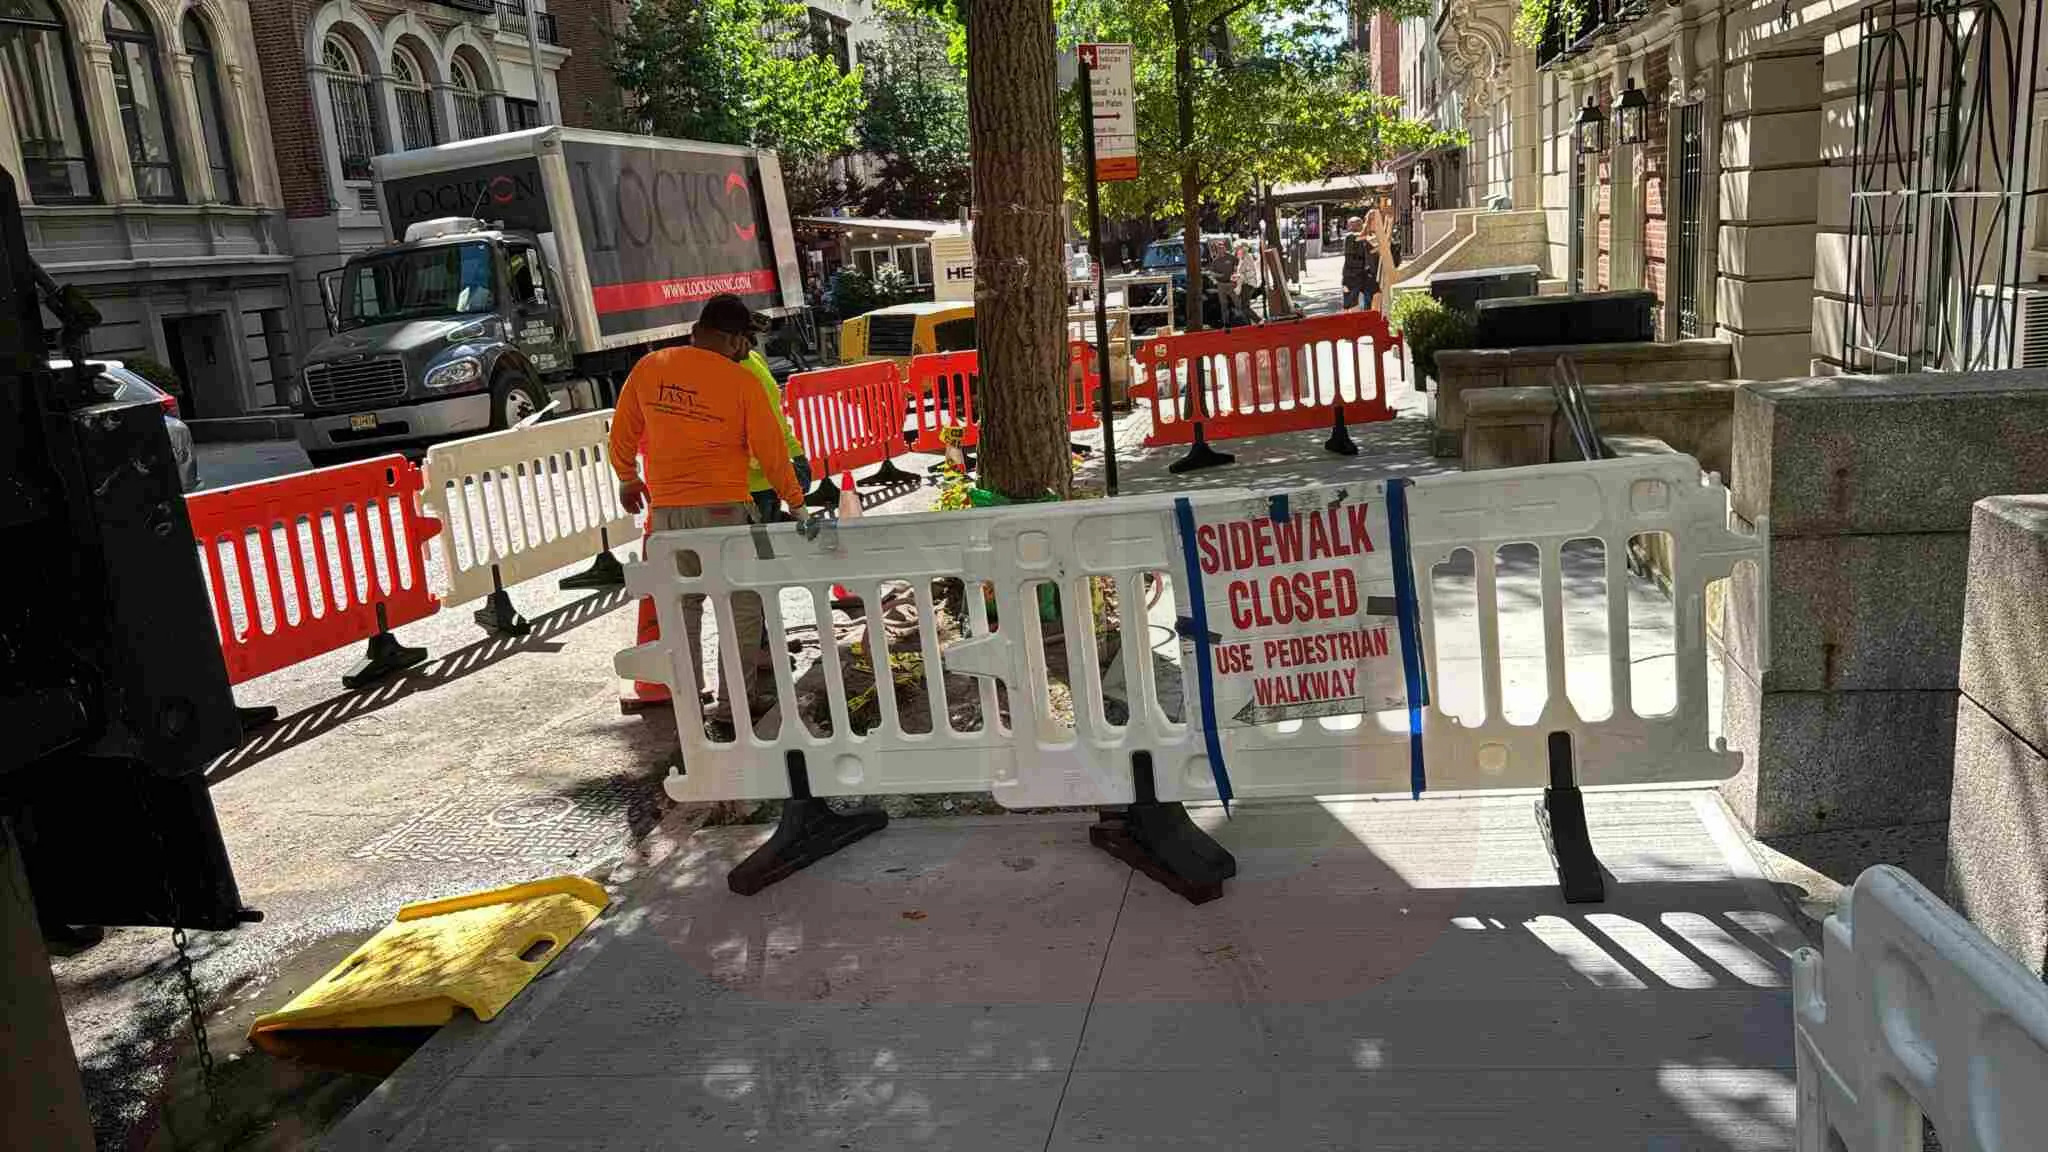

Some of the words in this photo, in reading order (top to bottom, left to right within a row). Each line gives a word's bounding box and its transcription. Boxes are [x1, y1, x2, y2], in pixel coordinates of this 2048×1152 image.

[397, 172, 537, 218] LOCKSON
[576, 160, 757, 251] LOCKSO
[1198, 503, 1375, 575] SIDEWALK
[1228, 568, 1359, 630] CLOSED
[1215, 643, 1254, 675] USE
[1264, 627, 1389, 669] PEDESTRIAN
[1254, 668, 1358, 706] WALKWAY
